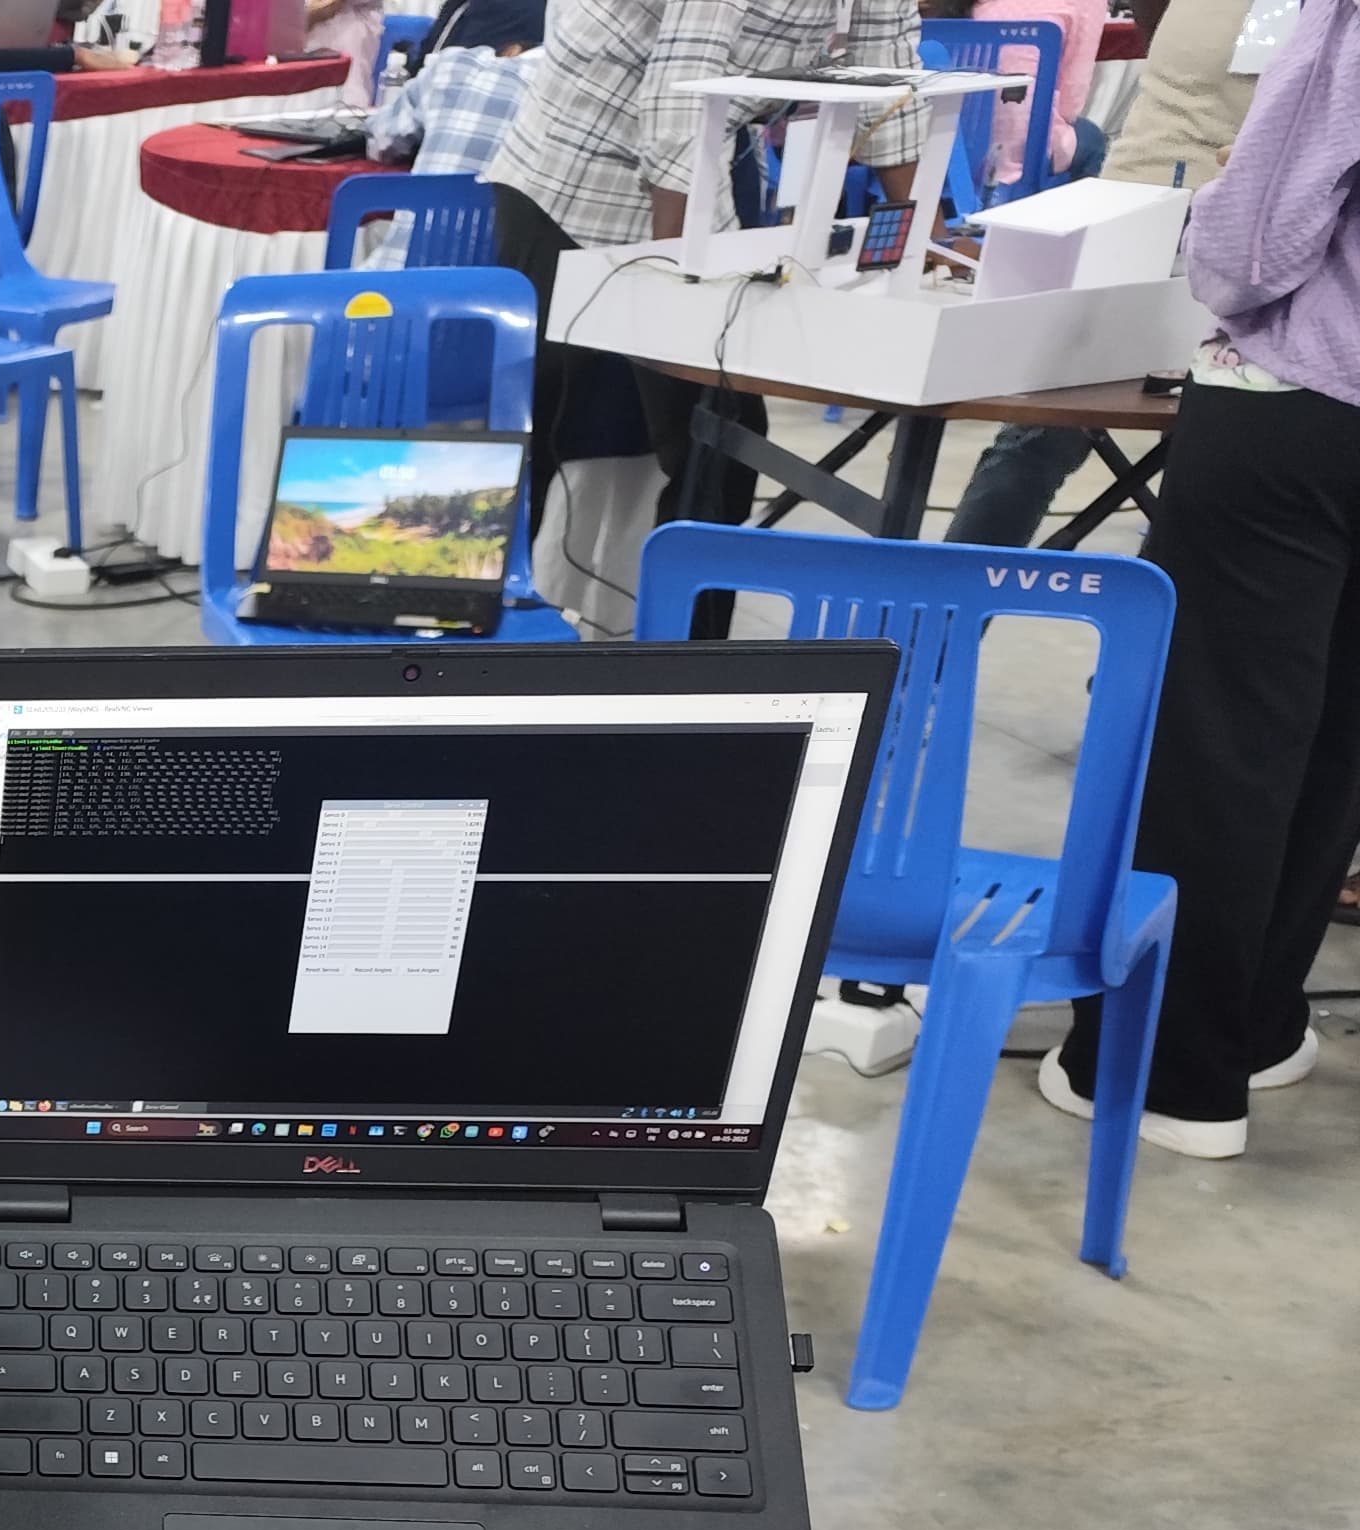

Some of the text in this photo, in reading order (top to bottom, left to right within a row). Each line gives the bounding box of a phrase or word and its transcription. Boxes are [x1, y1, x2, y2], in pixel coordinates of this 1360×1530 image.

[986, 567, 1102, 594] VVCE
[125, 1124, 149, 1133] Search
[303, 1157, 360, 1174] DELL
[66, 1327, 76, 1338] Q
[115, 1327, 128, 1338] W
[169, 1328, 176, 1338] E
[219, 1329, 227, 1339] R
[270, 1331, 278, 1341] T
[321, 1332, 330, 1342] Y
[373, 1333, 381, 1343] U
[476, 1335, 486, 1345] O
[530, 1335, 538, 1345] P
[80, 1368, 89, 1378] A
[131, 1369, 139, 1379] S
[181, 1370, 190, 1380] D
[233, 1372, 241, 1381] F
[284, 1373, 294, 1383] G
[336, 1374, 345, 1384] H
[390, 1375, 396, 1386] J
[440, 1377, 449, 1386] K
[494, 1378, 502, 1387] L
[106, 1410, 114, 1420] Z
[157, 1411, 166, 1421] X
[208, 1413, 217, 1423] C
[260, 1414, 269, 1424] V
[313, 1416, 321, 1426] B
[364, 1417, 375, 1428] N
[415, 1418, 428, 1429] M
